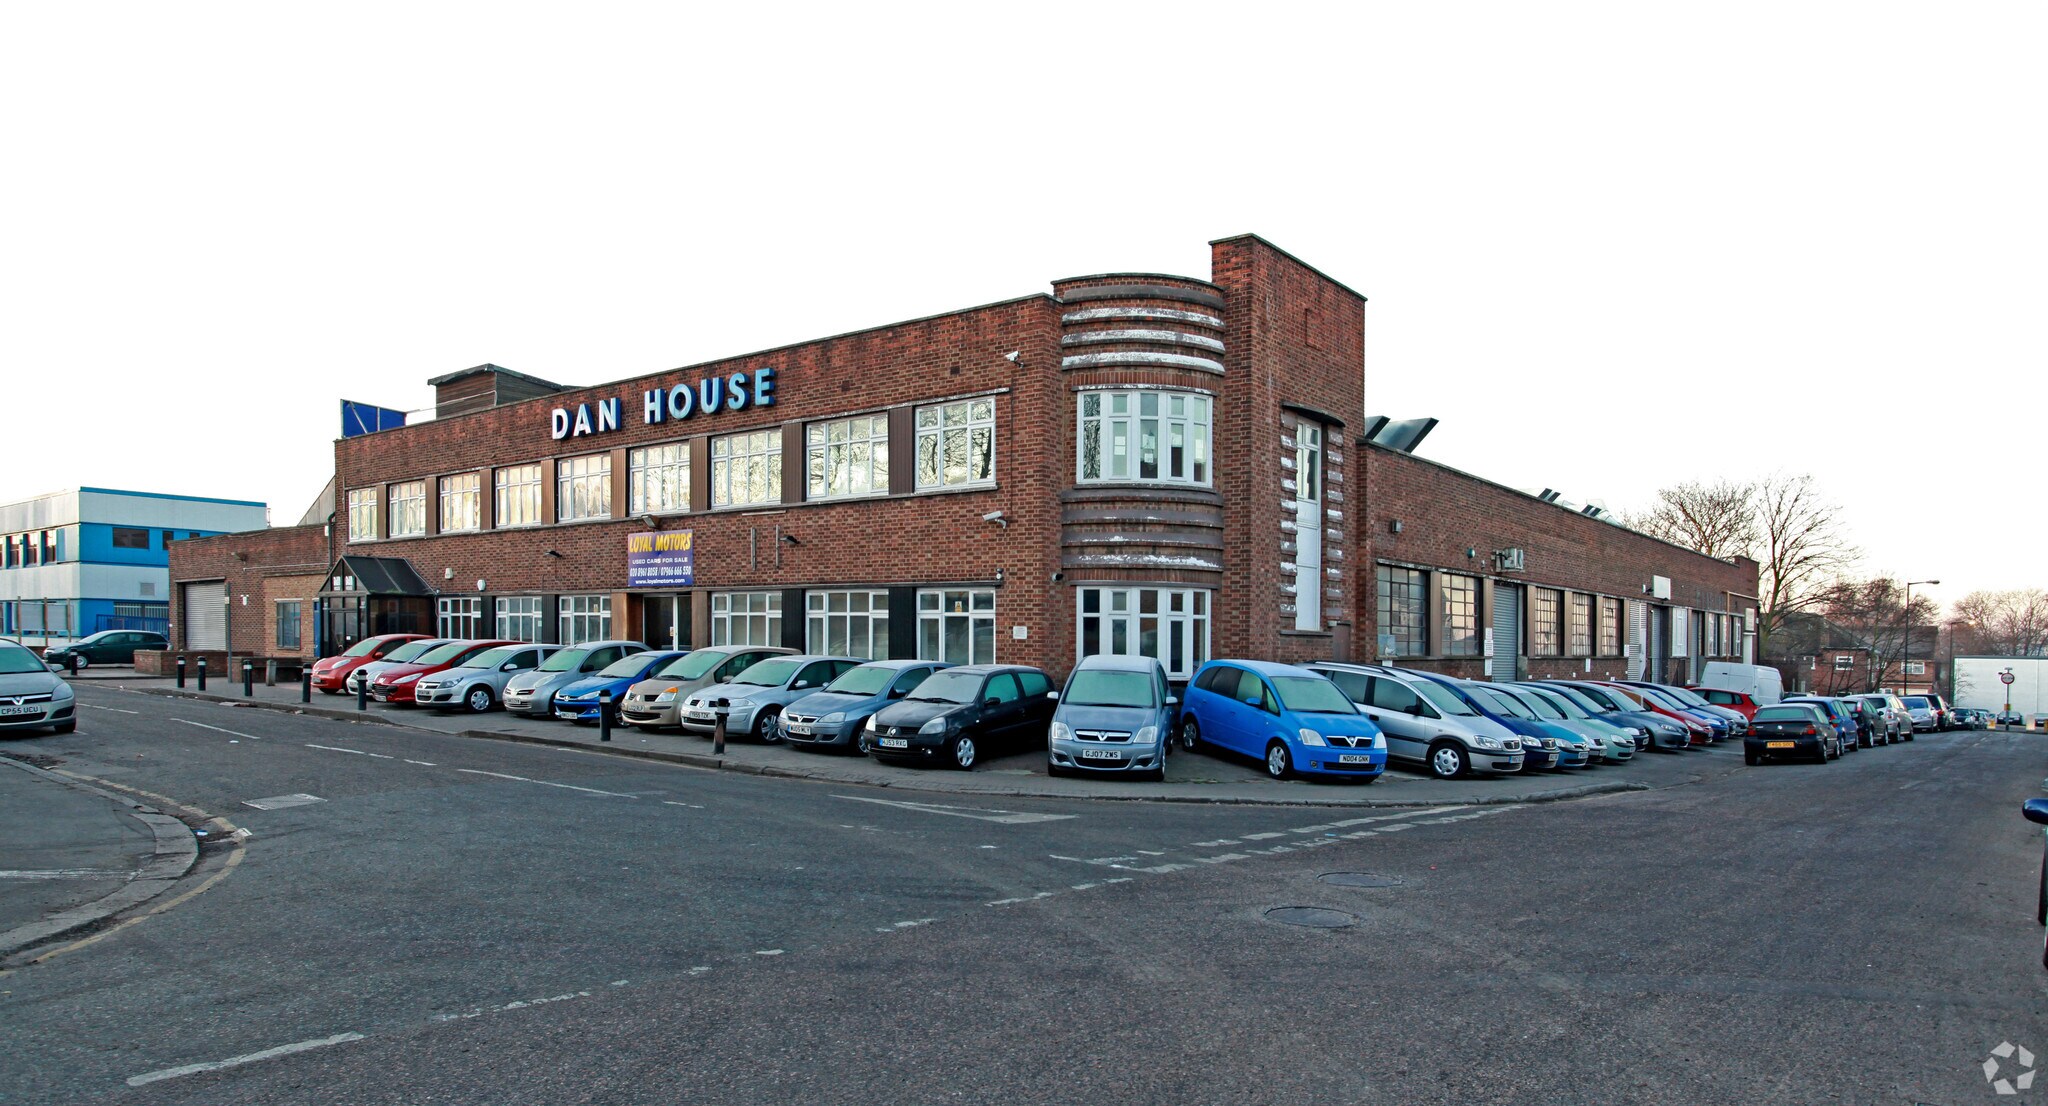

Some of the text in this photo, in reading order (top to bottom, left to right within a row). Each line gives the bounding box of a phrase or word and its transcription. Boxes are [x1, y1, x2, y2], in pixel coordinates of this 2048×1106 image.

[552, 368, 775, 440] DAN HOUSE
[630, 532, 692, 552] LOYAL MOTORS
[1085, 750, 1103, 758] GJ07
